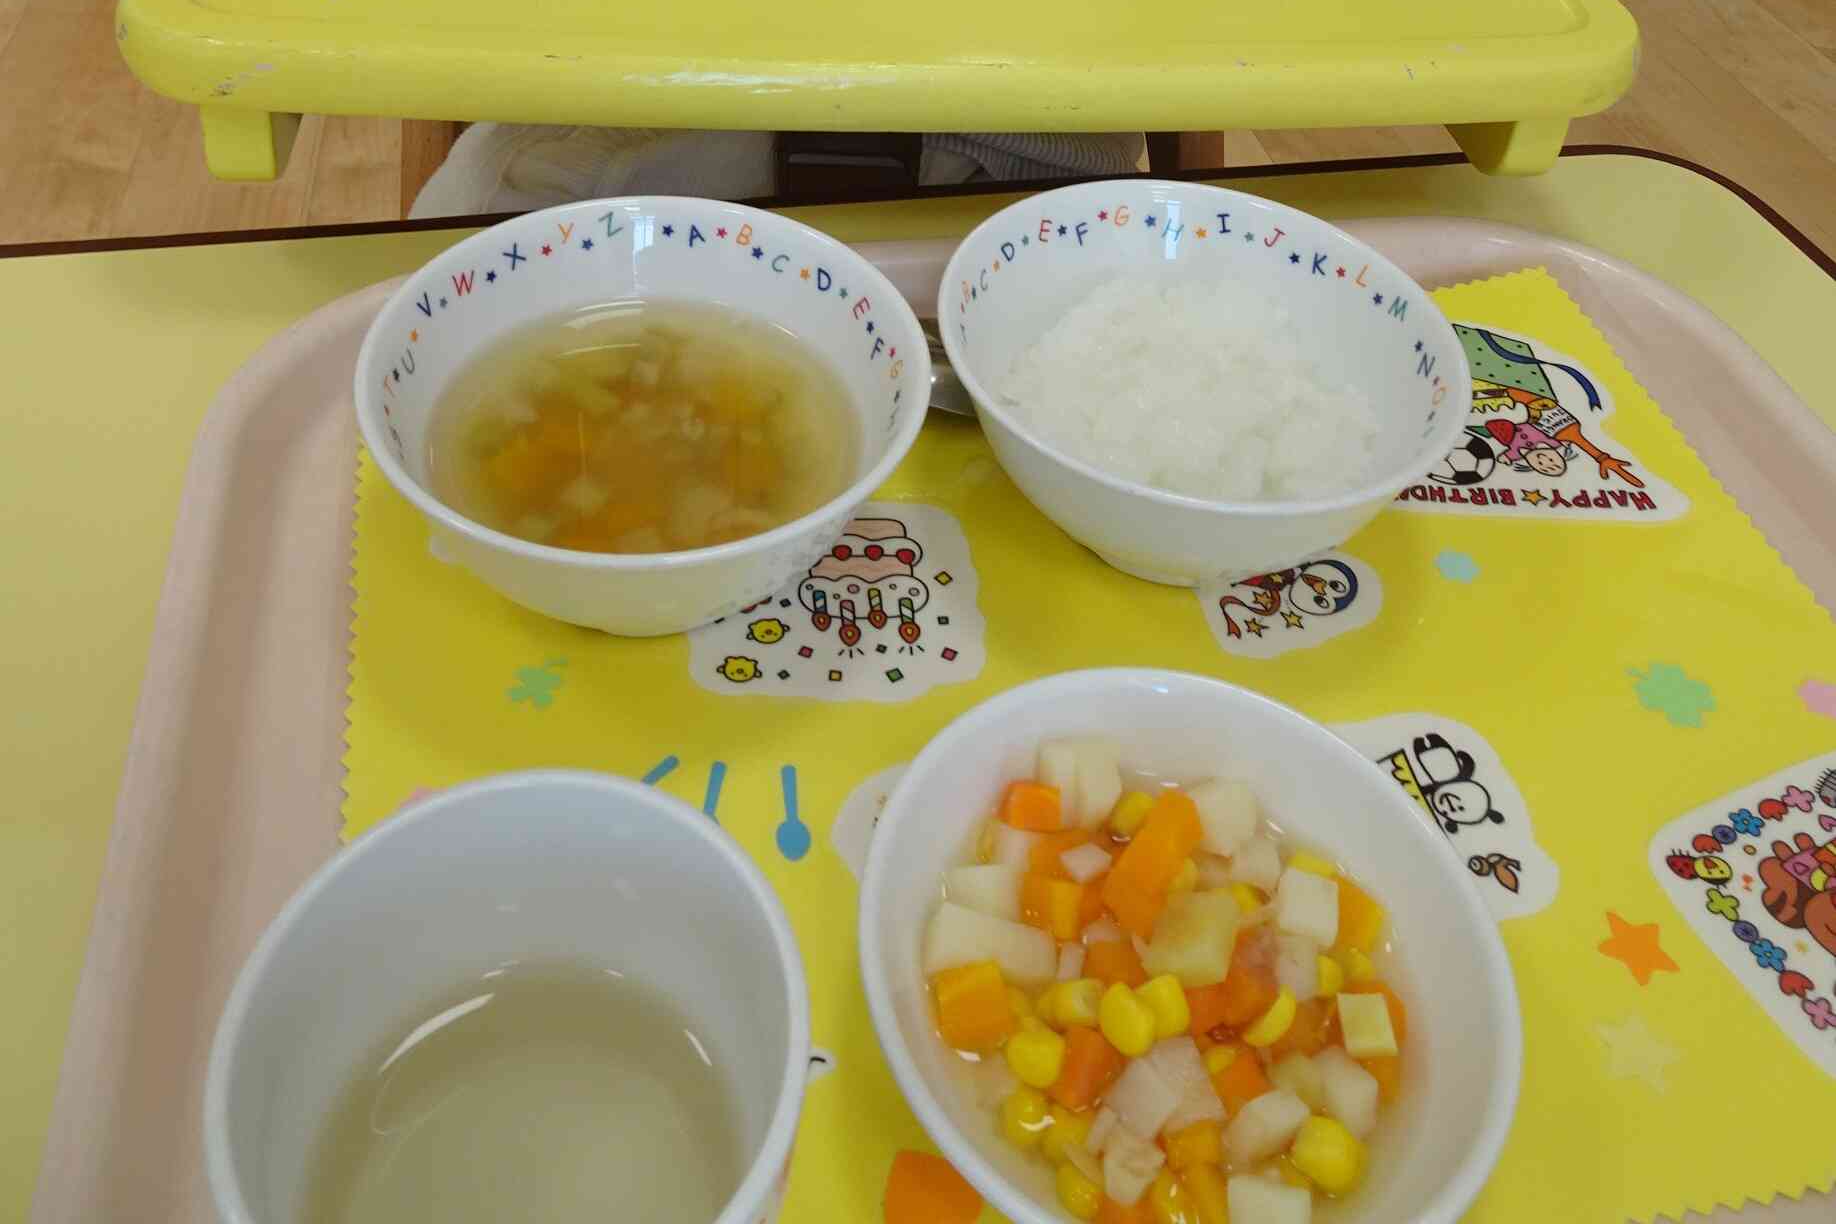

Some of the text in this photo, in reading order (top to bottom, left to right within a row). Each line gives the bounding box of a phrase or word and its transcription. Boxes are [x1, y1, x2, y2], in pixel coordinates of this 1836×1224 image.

[401, 348, 416, 375] U
[416, 292, 432, 317] V
[452, 270, 475, 297] W
[502, 242, 527, 271] X
[558, 223, 575, 244] Y
[598, 211, 624, 237] Z
[688, 224, 706, 248] A
[736, 224, 752, 246] B
[771, 254, 790, 273] C
[817, 267, 832, 293] D
[852, 297, 871, 320] E
[870, 337, 885, 360] F
[980, 268, 989, 292] C
[1001, 242, 1015, 262] D
[1038, 219, 1053, 243] E
[1075, 222, 1089, 246] F
[1114, 205, 1129, 227] G
[1161, 218, 1184, 241] H
[1216, 213, 1231, 233] I
[1264, 228, 1286, 247] J
[1312, 252, 1327, 275] K
[1355, 264, 1369, 287] L
[1387, 295, 1408, 321] M
[1417, 352, 1436, 377] N
[1549, 488, 1658, 511] HAPPY
